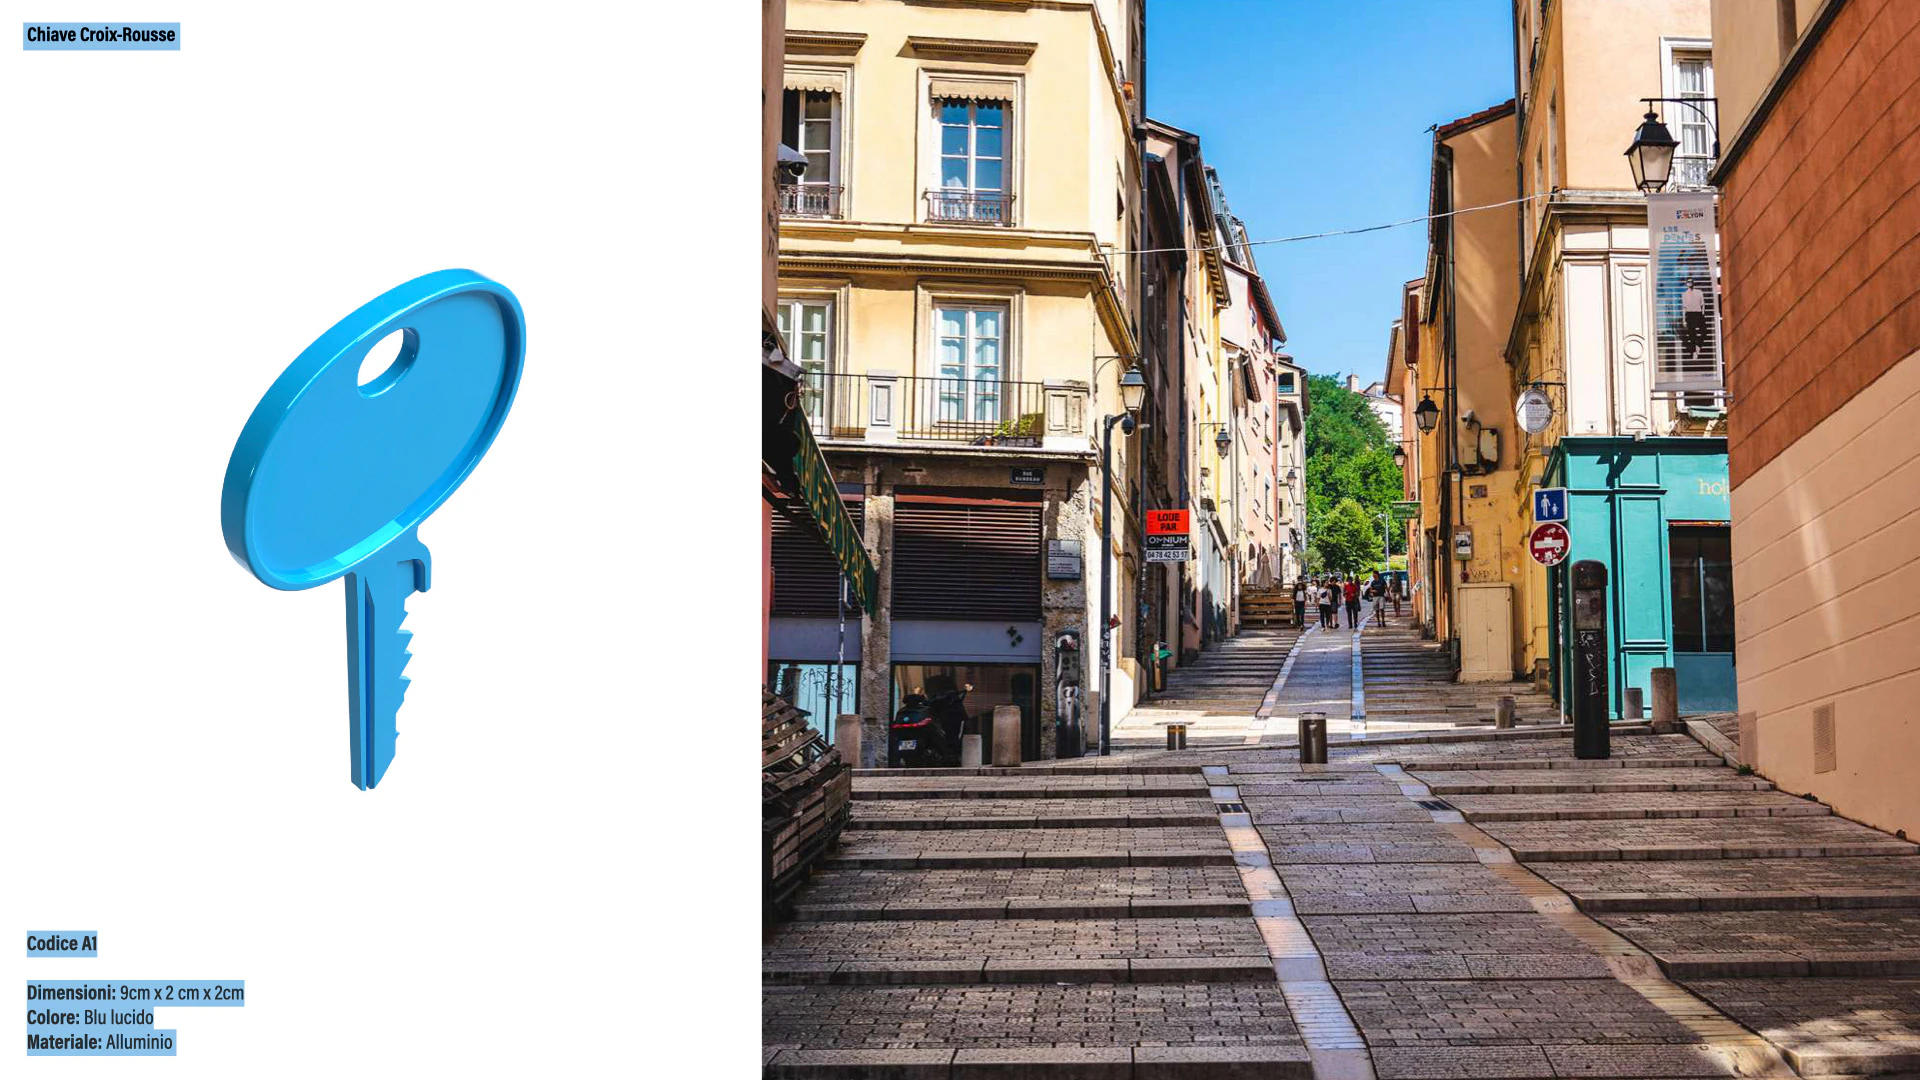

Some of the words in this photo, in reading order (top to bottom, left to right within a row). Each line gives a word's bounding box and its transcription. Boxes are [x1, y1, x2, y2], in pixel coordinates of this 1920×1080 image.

[1157, 513, 1181, 522] LOUE
[1160, 522, 1177, 531] PAR
[1148, 536, 1188, 544] OMNIUM
